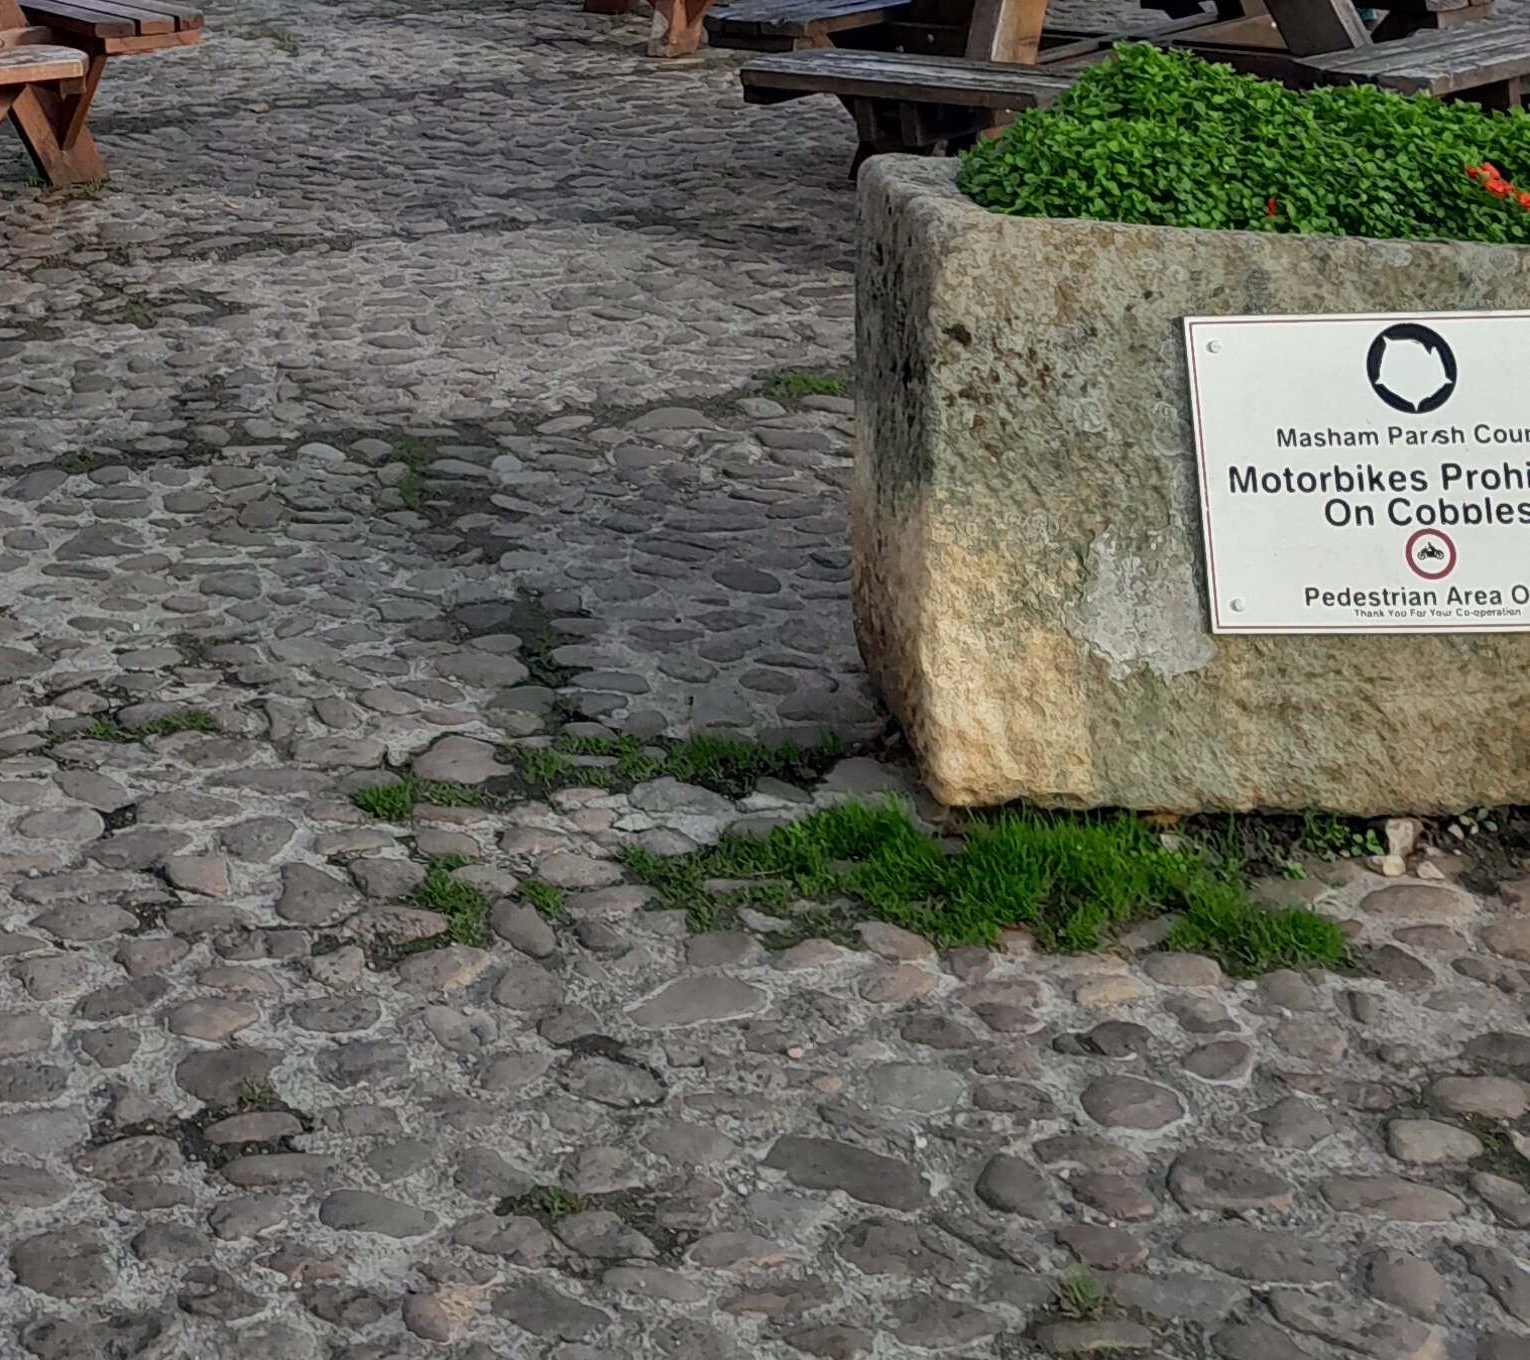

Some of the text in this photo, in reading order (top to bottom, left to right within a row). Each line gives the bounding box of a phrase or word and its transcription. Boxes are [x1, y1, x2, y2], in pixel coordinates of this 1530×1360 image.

[1276, 426, 1379, 448] Masham
[1228, 463, 1429, 494] Motorbikes
[1324, 496, 1530, 527] On Cobbles
[1305, 586, 1438, 607] Pedestrian
[1446, 586, 1502, 606] Area
[1354, 606, 1522, 618] Thank You For Your Co-operation
